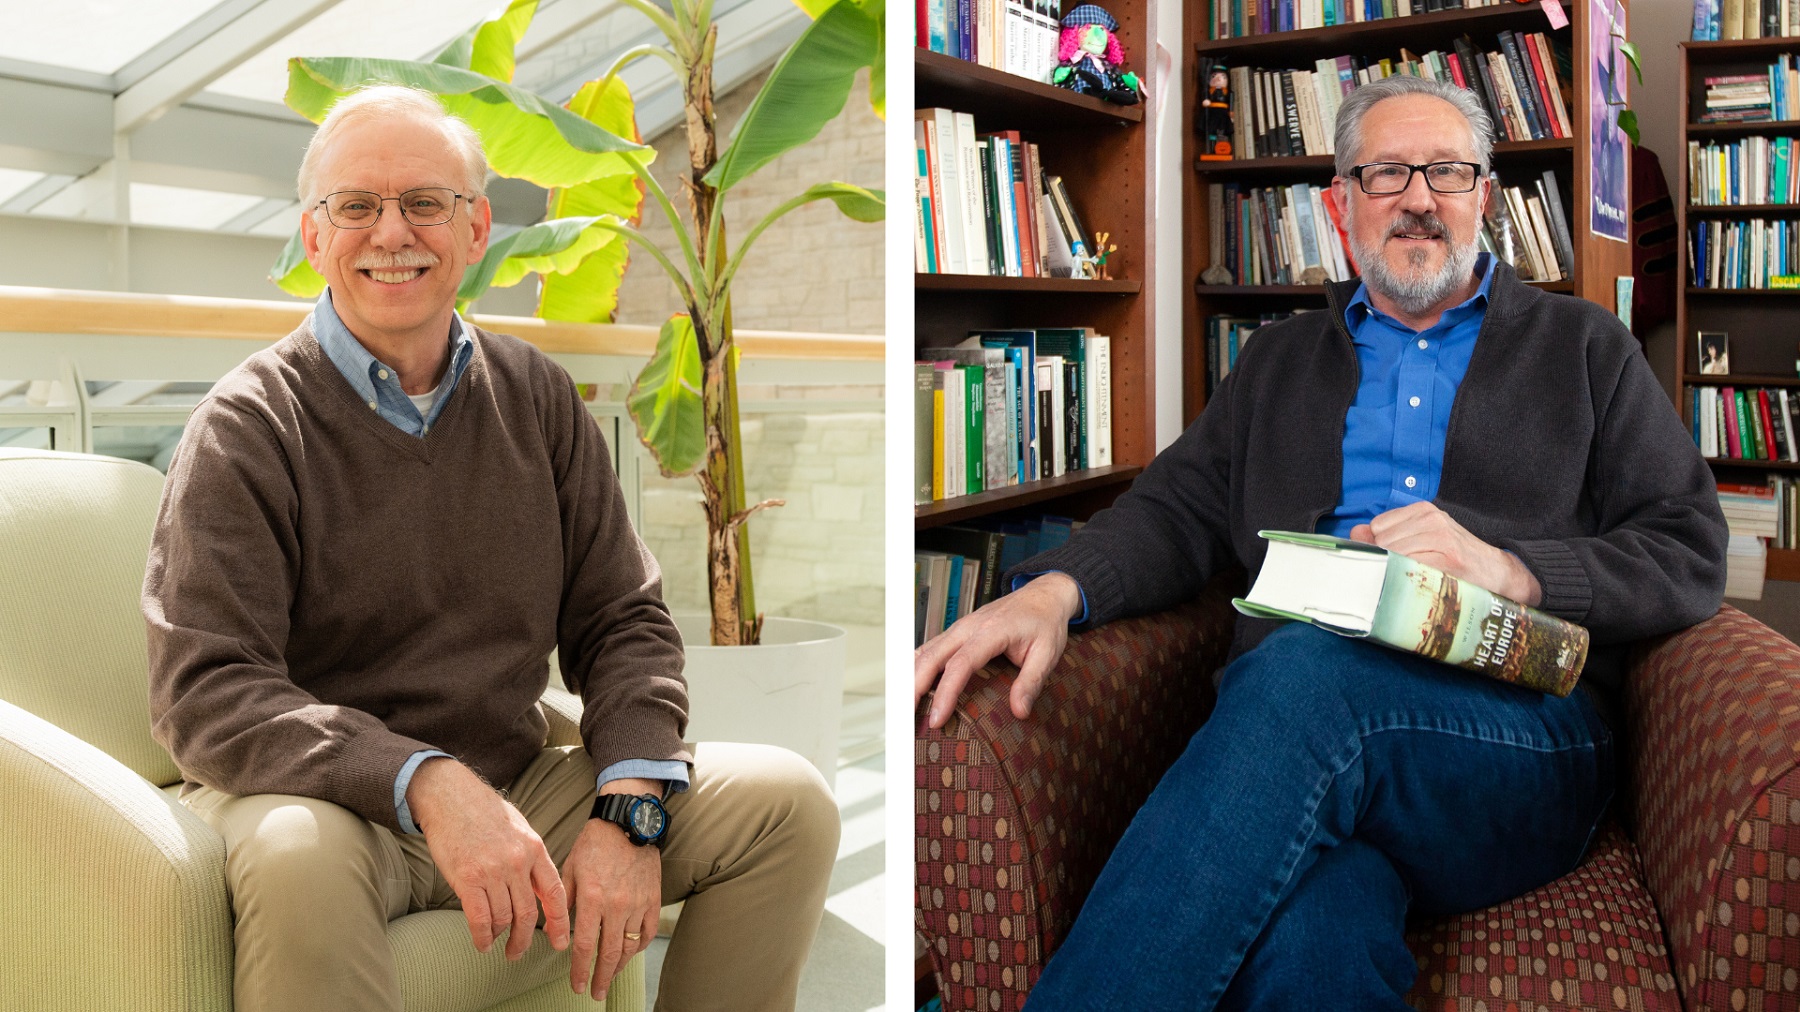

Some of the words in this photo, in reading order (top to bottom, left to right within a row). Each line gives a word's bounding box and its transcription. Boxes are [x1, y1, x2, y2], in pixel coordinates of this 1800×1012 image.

[1286, 104, 1301, 139] SWERVE
[988, 542, 997, 570] SELECTED
[984, 570, 992, 594] LETTERS
[1462, 607, 1476, 643] WILSON
[1474, 620, 1499, 667] HEART
[1490, 597, 1504, 617] OF
[1491, 609, 1517, 666] EUROPE
